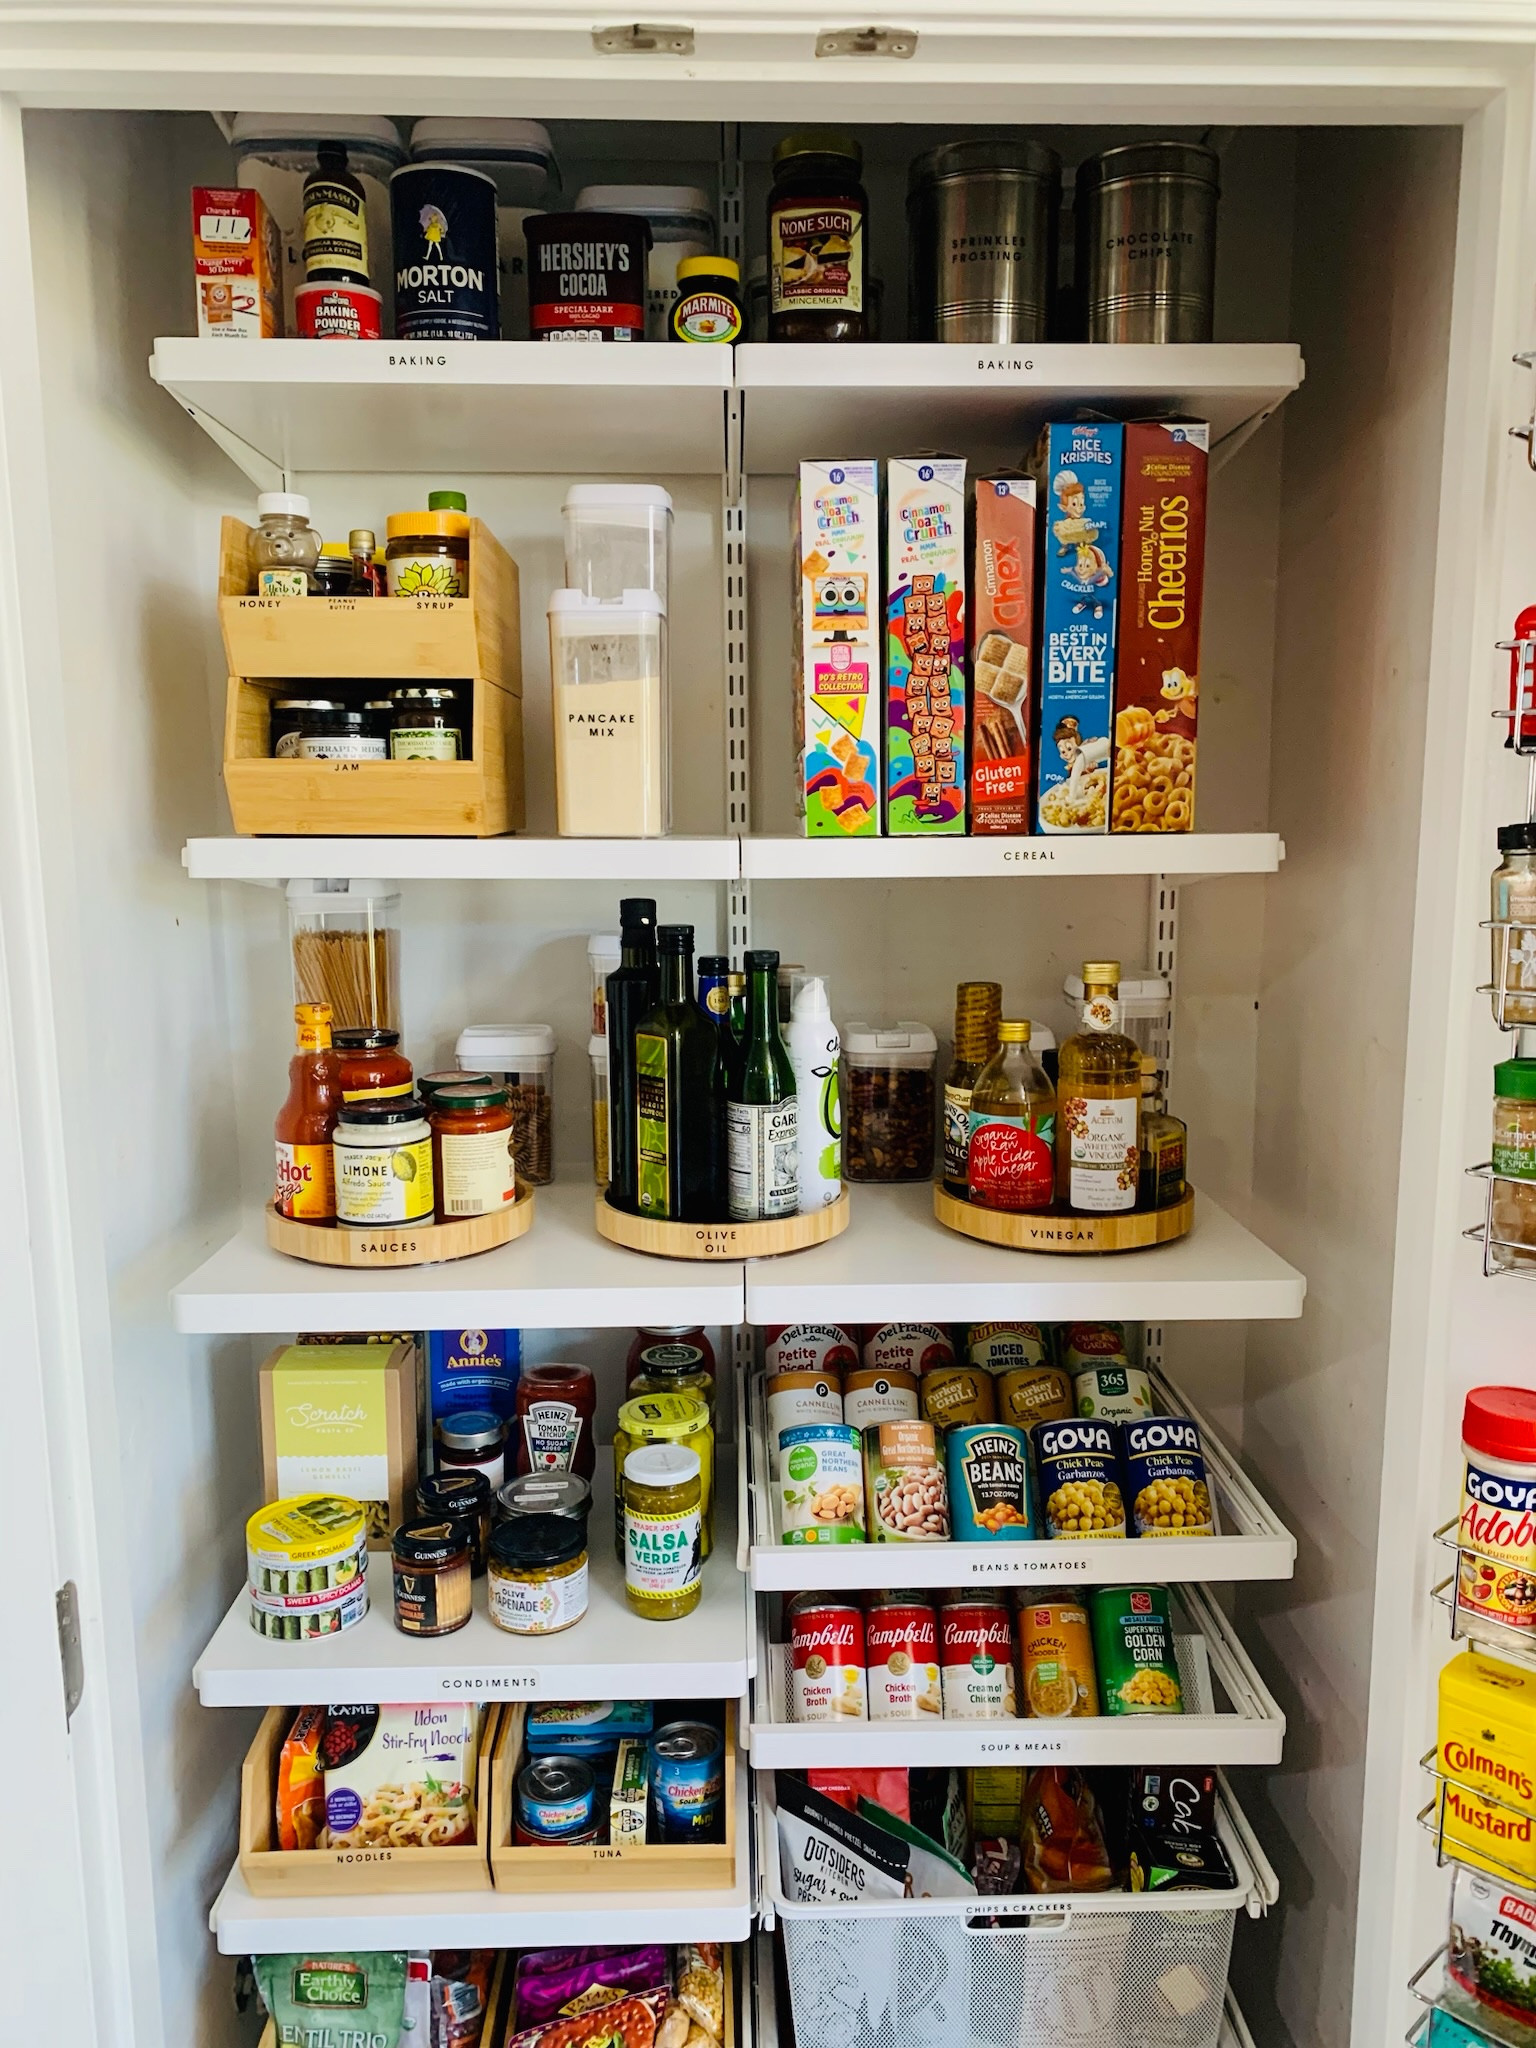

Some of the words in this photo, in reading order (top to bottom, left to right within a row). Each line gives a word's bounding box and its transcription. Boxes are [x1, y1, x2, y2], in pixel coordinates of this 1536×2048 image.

[781, 216, 814, 235] NONE
[817, 215, 850, 232] SUCH
[951, 235, 1026, 249] SPRINKLES
[1106, 233, 1193, 249] CHOCOLATE
[540, 242, 629, 272] HERSHEY'S
[951, 251, 1022, 264] FROSTING
[1128, 248, 1172, 260] CHIPS
[397, 265, 484, 292] MORTON
[559, 273, 607, 297] COCOA
[418, 290, 455, 304] SALT
[784, 287, 812, 296] CLASSIC
[813, 287, 846, 295] ORIGINAL
[788, 297, 843, 306] MINCEMEAT
[316, 306, 358, 318] BAKING
[554, 305, 588, 314] SPECIAL
[590, 305, 614, 314] DARK
[682, 297, 735, 321] MARMITE
[315, 318, 360, 331] POWDER
[389, 356, 446, 366] BAKING
[978, 360, 1034, 370] BAKING
[1072, 439, 1101, 450] RICE
[1060, 451, 1112, 465] KRISPIES
[814, 494, 859, 511] Cinnamon
[824, 504, 851, 517] Toast
[900, 504, 951, 521] Cinnamon
[817, 511, 860, 529] Crunch
[911, 513, 943, 528] Toast
[1139, 505, 1155, 532] Nut
[1085, 521, 1107, 530] SNAP!
[904, 522, 952, 543] Crunch
[1137, 537, 1158, 583] Honey
[1147, 495, 1189, 630] Cheerios
[983, 539, 997, 596] Cinnamon
[992, 537, 1026, 627] Chex
[1061, 579, 1095, 593] CRACKLE!
[239, 600, 281, 608] HONEY
[416, 602, 455, 610] SYRUP
[1049, 633, 1088, 646] BEST
[1091, 633, 1107, 645] IN
[1049, 646, 1106, 661] EVERY
[1048, 661, 1106, 683] BITE
[818, 682, 864, 691] COLLECTION
[568, 714, 635, 723] PANCAKE
[589, 728, 614, 736] MIX
[334, 763, 360, 771] JAM
[975, 764, 1022, 783] Gluten
[985, 781, 1014, 795] Free
[1003, 851, 1055, 861] CEREAL
[974, 1130, 1018, 1149] Organic
[1088, 1133, 1125, 1141] ORGANIC
[990, 1140, 1018, 1151] Raw
[973, 1150, 996, 1172] Apple
[1001, 1148, 1035, 1164] Cider
[1089, 1152, 1124, 1160] VINEGAR
[343, 1164, 388, 1177] LIMONE
[1507, 1158, 1534, 1171] SPICE
[342, 1178, 366, 1187] Alfredo
[368, 1178, 391, 1186] Sauce
[695, 1230, 737, 1240] OLIVE
[1030, 1229, 1094, 1240] VINEGAR
[360, 1242, 417, 1253] SAUCES
[704, 1244, 727, 1254] OIL
[781, 1326, 800, 1345] Dei
[802, 1325, 844, 1344] Fratelli
[877, 1324, 897, 1344] Dei
[899, 1323, 941, 1342] Fratelli
[778, 1348, 817, 1363] Petite
[874, 1346, 914, 1361] Petite
[990, 1344, 1024, 1357] DICED
[447, 1354, 502, 1369] Annie's
[986, 1356, 1030, 1367] TOMATOES
[1100, 1373, 1125, 1387] 365
[927, 1383, 963, 1405] Turkey
[1013, 1382, 1052, 1400] Turkey
[935, 1389, 974, 1410] CHILI
[1025, 1389, 1061, 1407] CHILI
[286, 1403, 368, 1428] Scratch
[537, 1411, 567, 1421] HEINZ
[1101, 1406, 1133, 1417] Organic
[537, 1424, 567, 1432] TOMATO
[1042, 1428, 1112, 1454] GOYA
[1130, 1426, 1199, 1451] GOYA
[974, 1439, 1016, 1457] HEINZ
[790, 1463, 815, 1472] organic
[1056, 1459, 1082, 1469] Chick
[1083, 1458, 1104, 1468] Peas
[1146, 1456, 1171, 1467] Chick
[1174, 1455, 1194, 1466] Peas
[969, 1463, 1023, 1483] BEANS
[1057, 1470, 1106, 1481] Garbanzos
[1148, 1467, 1195, 1478] Garbanzos
[448, 1497, 478, 1509] GUINNESS
[629, 1529, 688, 1551] SALSA
[292, 1551, 316, 1560] GREEK
[317, 1542, 347, 1556] DOLMAS
[414, 1549, 447, 1560] GUINNESS
[635, 1550, 680, 1564] VERDE
[972, 1563, 1009, 1572] BEANS
[1013, 1563, 1019, 1571] &
[1024, 1562, 1087, 1571] TOMATOES
[287, 1597, 310, 1605] SWEET
[320, 1590, 339, 1602] SPICY
[340, 1577, 362, 1594] DOLMAS
[501, 1588, 525, 1599] OLIVE
[1124, 1626, 1163, 1634] SUPERSWEET
[1027, 1637, 1067, 1654] CHICKEN
[1124, 1635, 1165, 1648] GOLDEN
[1133, 1648, 1163, 1662] CORN
[442, 1678, 536, 1689] CONDIMENTS
[885, 1683, 916, 1693] Chicken
[802, 1686, 832, 1696] Chicken
[806, 1696, 827, 1706] Broth
[889, 1694, 912, 1703] Broth
[970, 1694, 1001, 1704] Chicken
[414, 1709, 447, 1726] Udon
[981, 1743, 1010, 1751] SOUP
[1014, 1743, 1020, 1751] &
[1025, 1743, 1061, 1751] MEALS
[1444, 1741, 1533, 1800] Colman's
[668, 1785, 704, 1797] Chicken
[1446, 1790, 1531, 1842] Mustard
[337, 1852, 392, 1863] NOODLES
[593, 1850, 622, 1858] TUNA
[793, 1867, 828, 1895] sugar
[820, 1866, 849, 1887] KITCHEN
[966, 1905, 1001, 1914] CHIPS
[1002, 1905, 1010, 1913] &
[1013, 1903, 1073, 1912] CRACKERS
[300, 1973, 356, 1989] Earthly
[306, 1987, 361, 2003] Choice
[340, 2029, 387, 2048] TRIO
